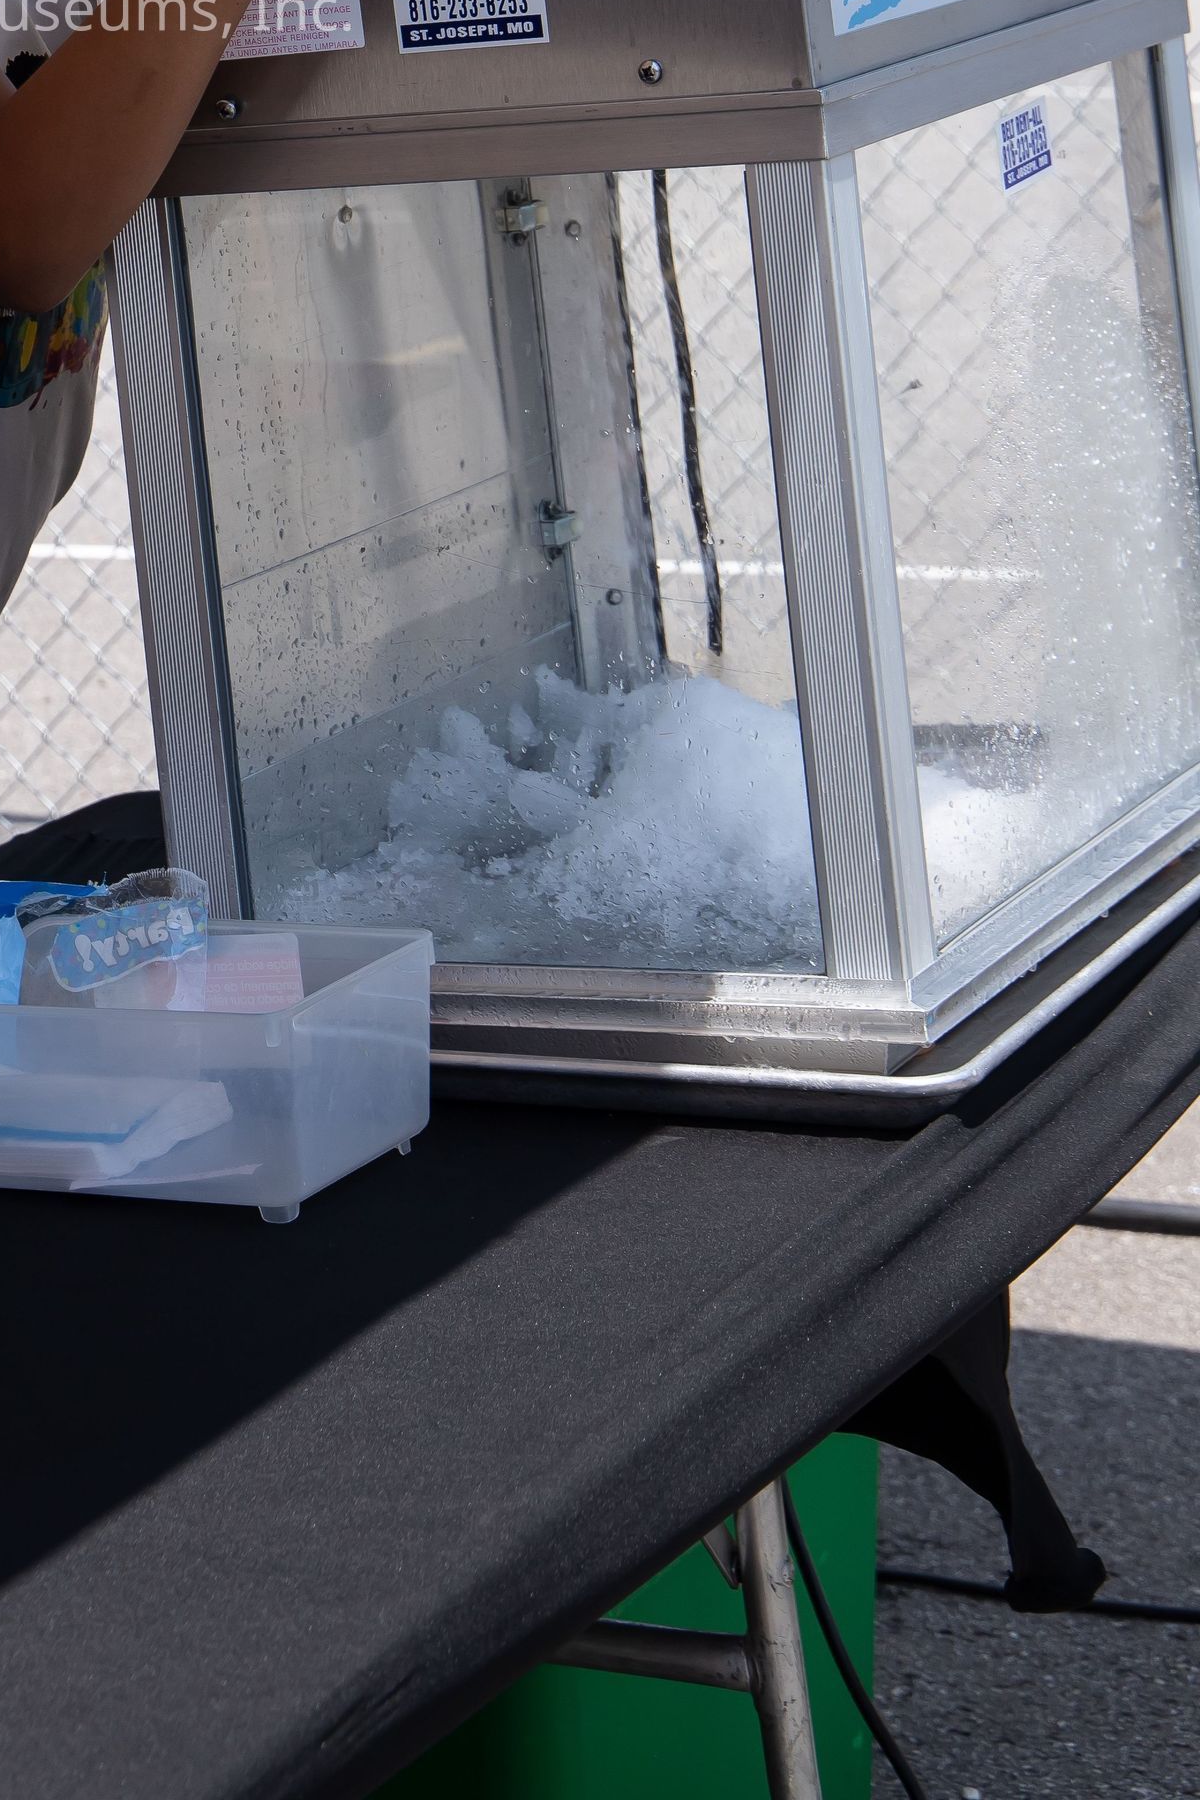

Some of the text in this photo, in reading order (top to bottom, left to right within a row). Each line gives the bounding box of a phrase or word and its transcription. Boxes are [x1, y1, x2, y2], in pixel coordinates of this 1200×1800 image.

[244, 35, 287, 46] MASCHINE
[290, 31, 330, 42] REINIGEN
[410, 21, 534, 41] ST. JOSEPH, MO
[238, 47, 269, 58] UNIDAD
[271, 46, 298, 56] ANTES
[300, 44, 312, 53] DE
[314, 40, 358, 51] LIMPIARLA
